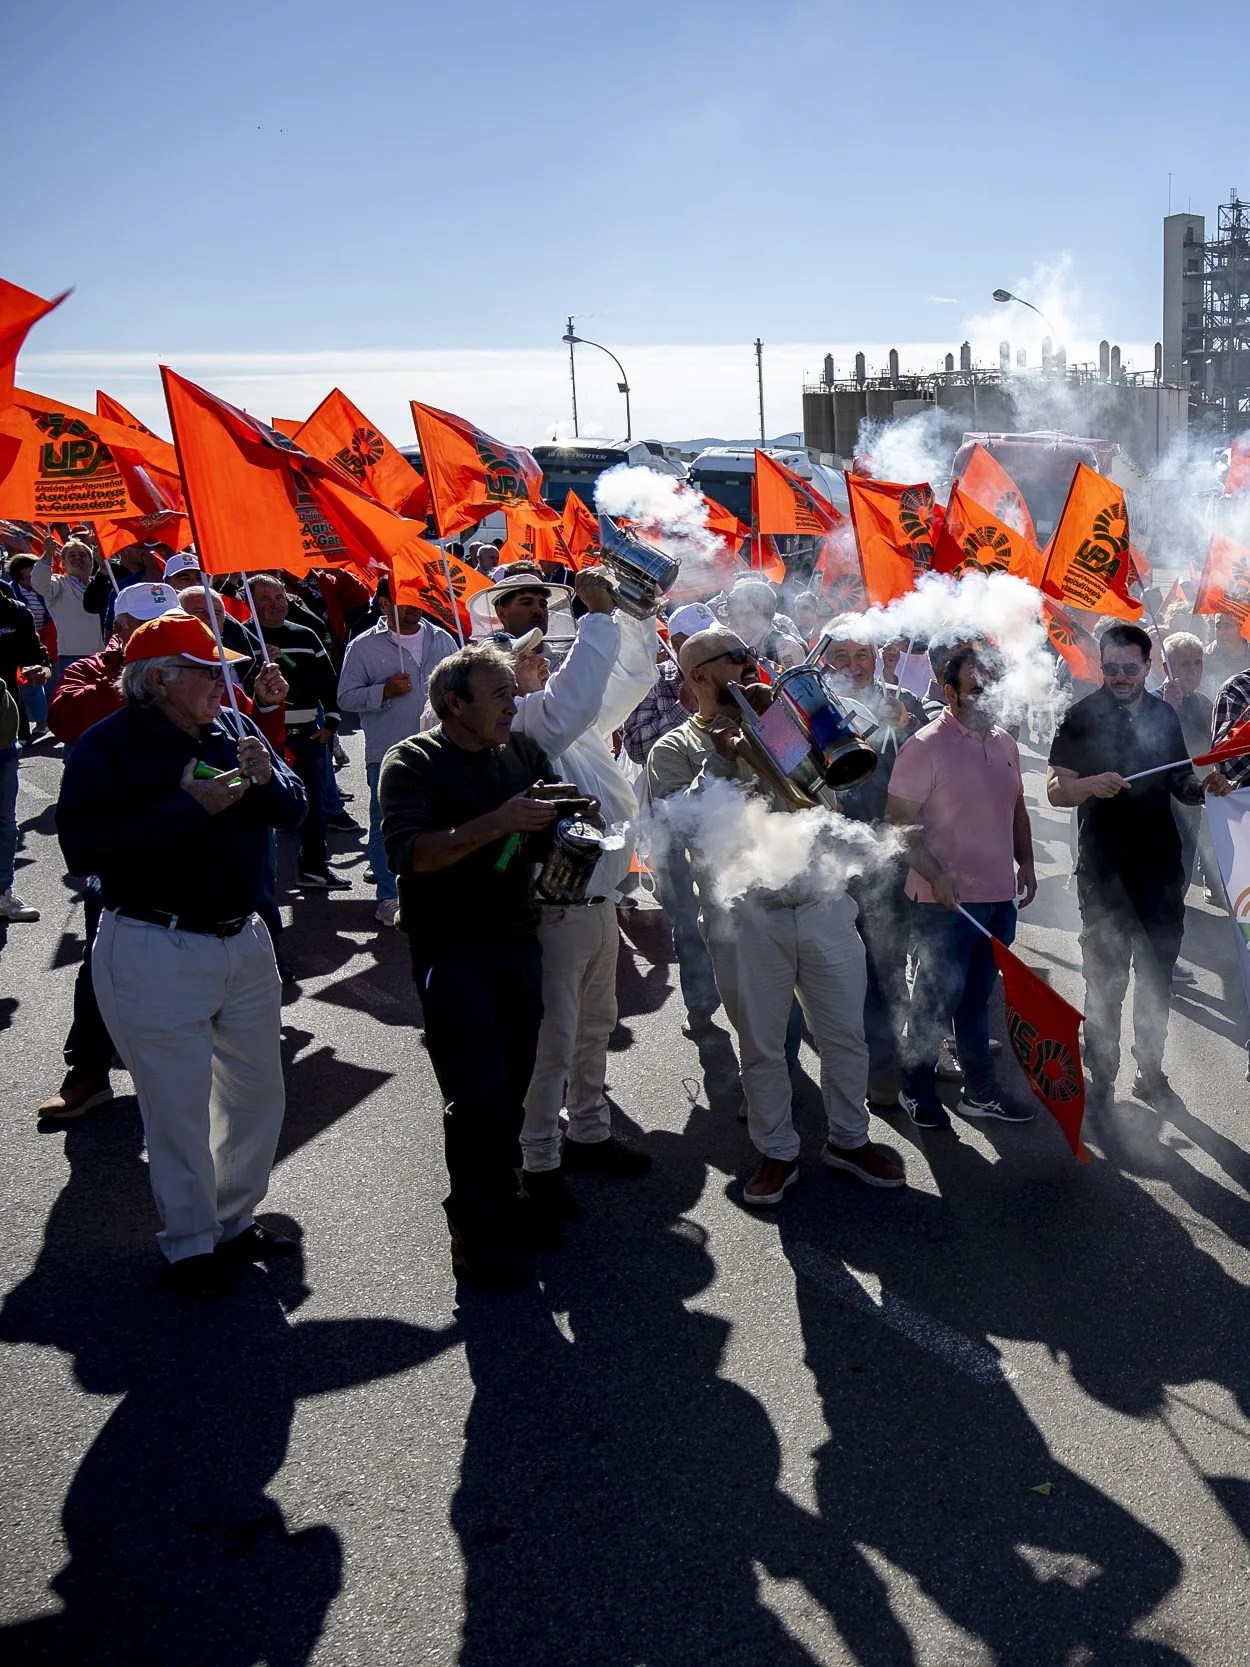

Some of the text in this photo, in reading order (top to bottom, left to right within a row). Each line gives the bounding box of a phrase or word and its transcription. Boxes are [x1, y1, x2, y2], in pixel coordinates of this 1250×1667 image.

[36, 488, 126, 502] Agricultores
[485, 473, 530, 500] UPA
[50, 499, 127, 511] Ganaderos
[1075, 539, 1121, 579] UPA
